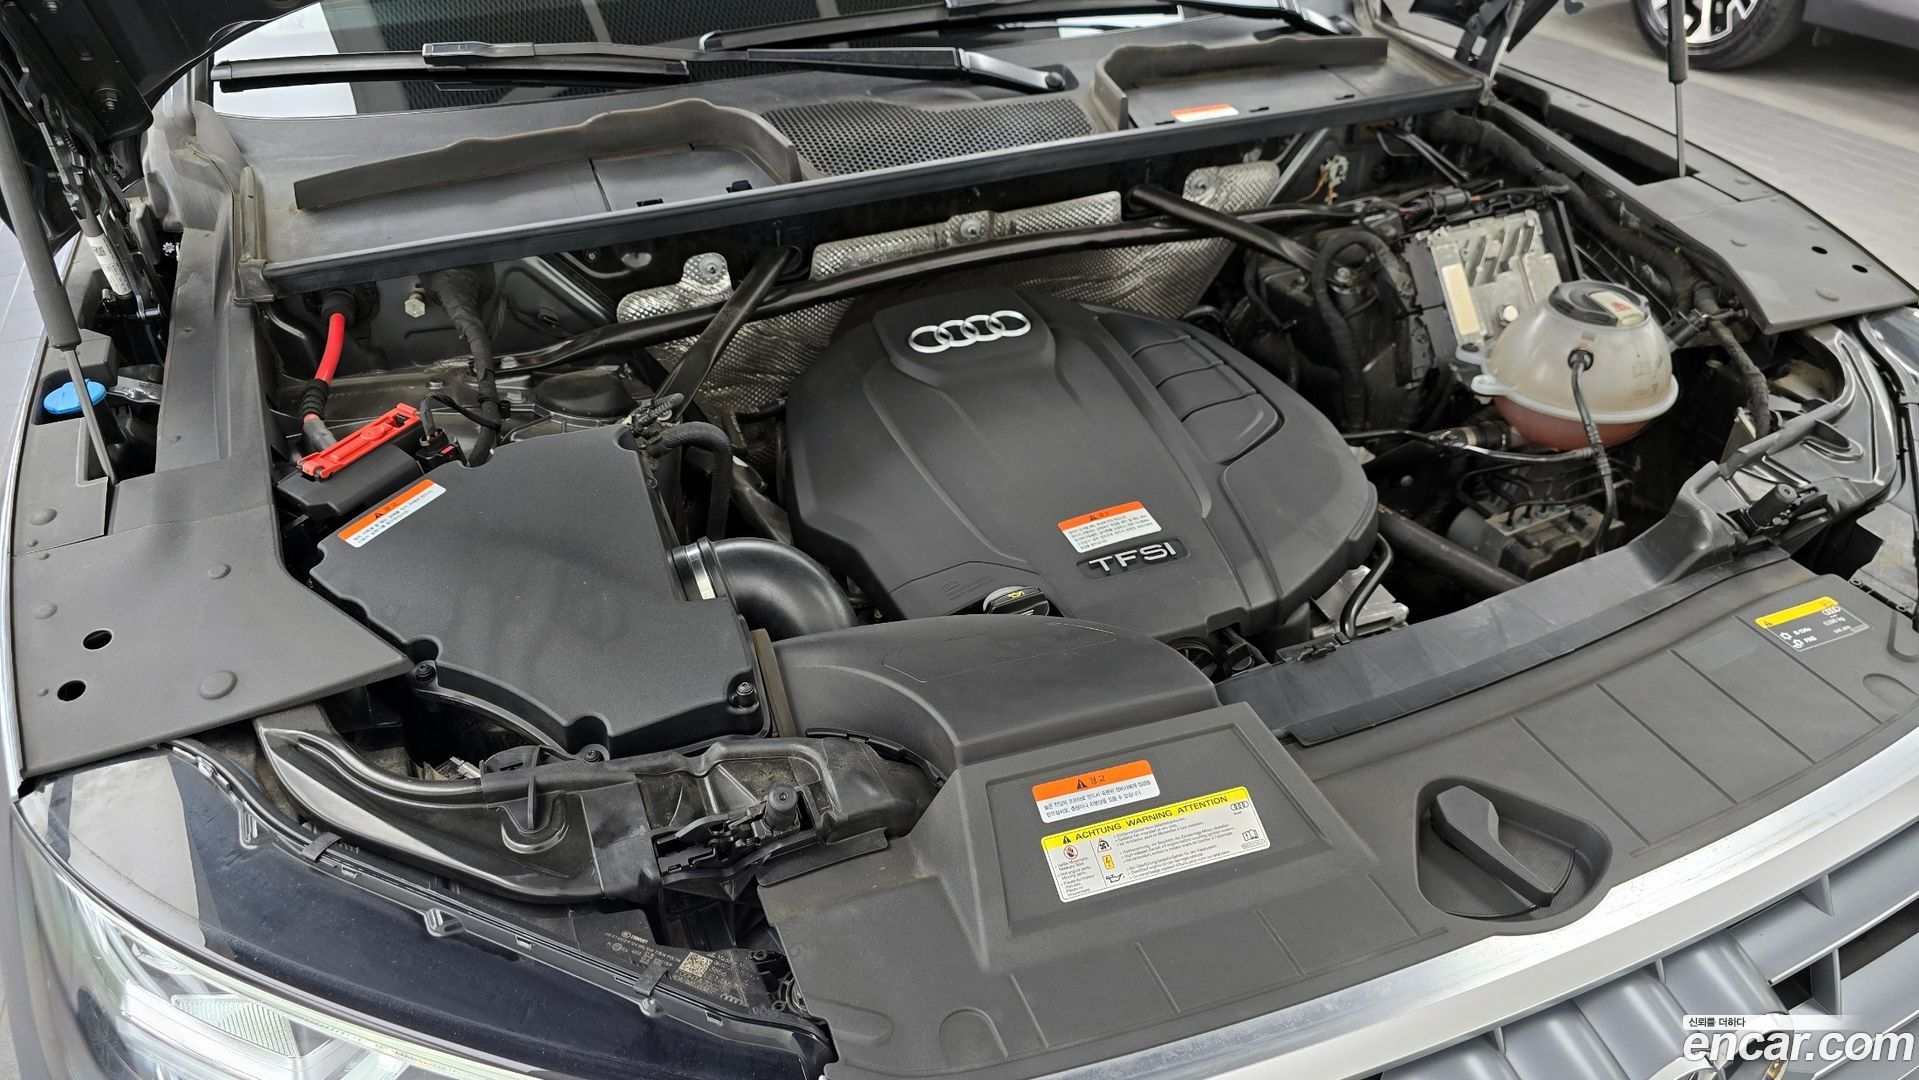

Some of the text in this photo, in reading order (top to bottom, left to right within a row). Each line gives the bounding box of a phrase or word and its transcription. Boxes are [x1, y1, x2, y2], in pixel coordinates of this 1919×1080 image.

[1088, 541, 1177, 572] TFSI
[1075, 823, 1122, 841] ACHTUNG
[1125, 809, 1173, 827] WARNING
[1177, 795, 1228, 814] ATTENTION
